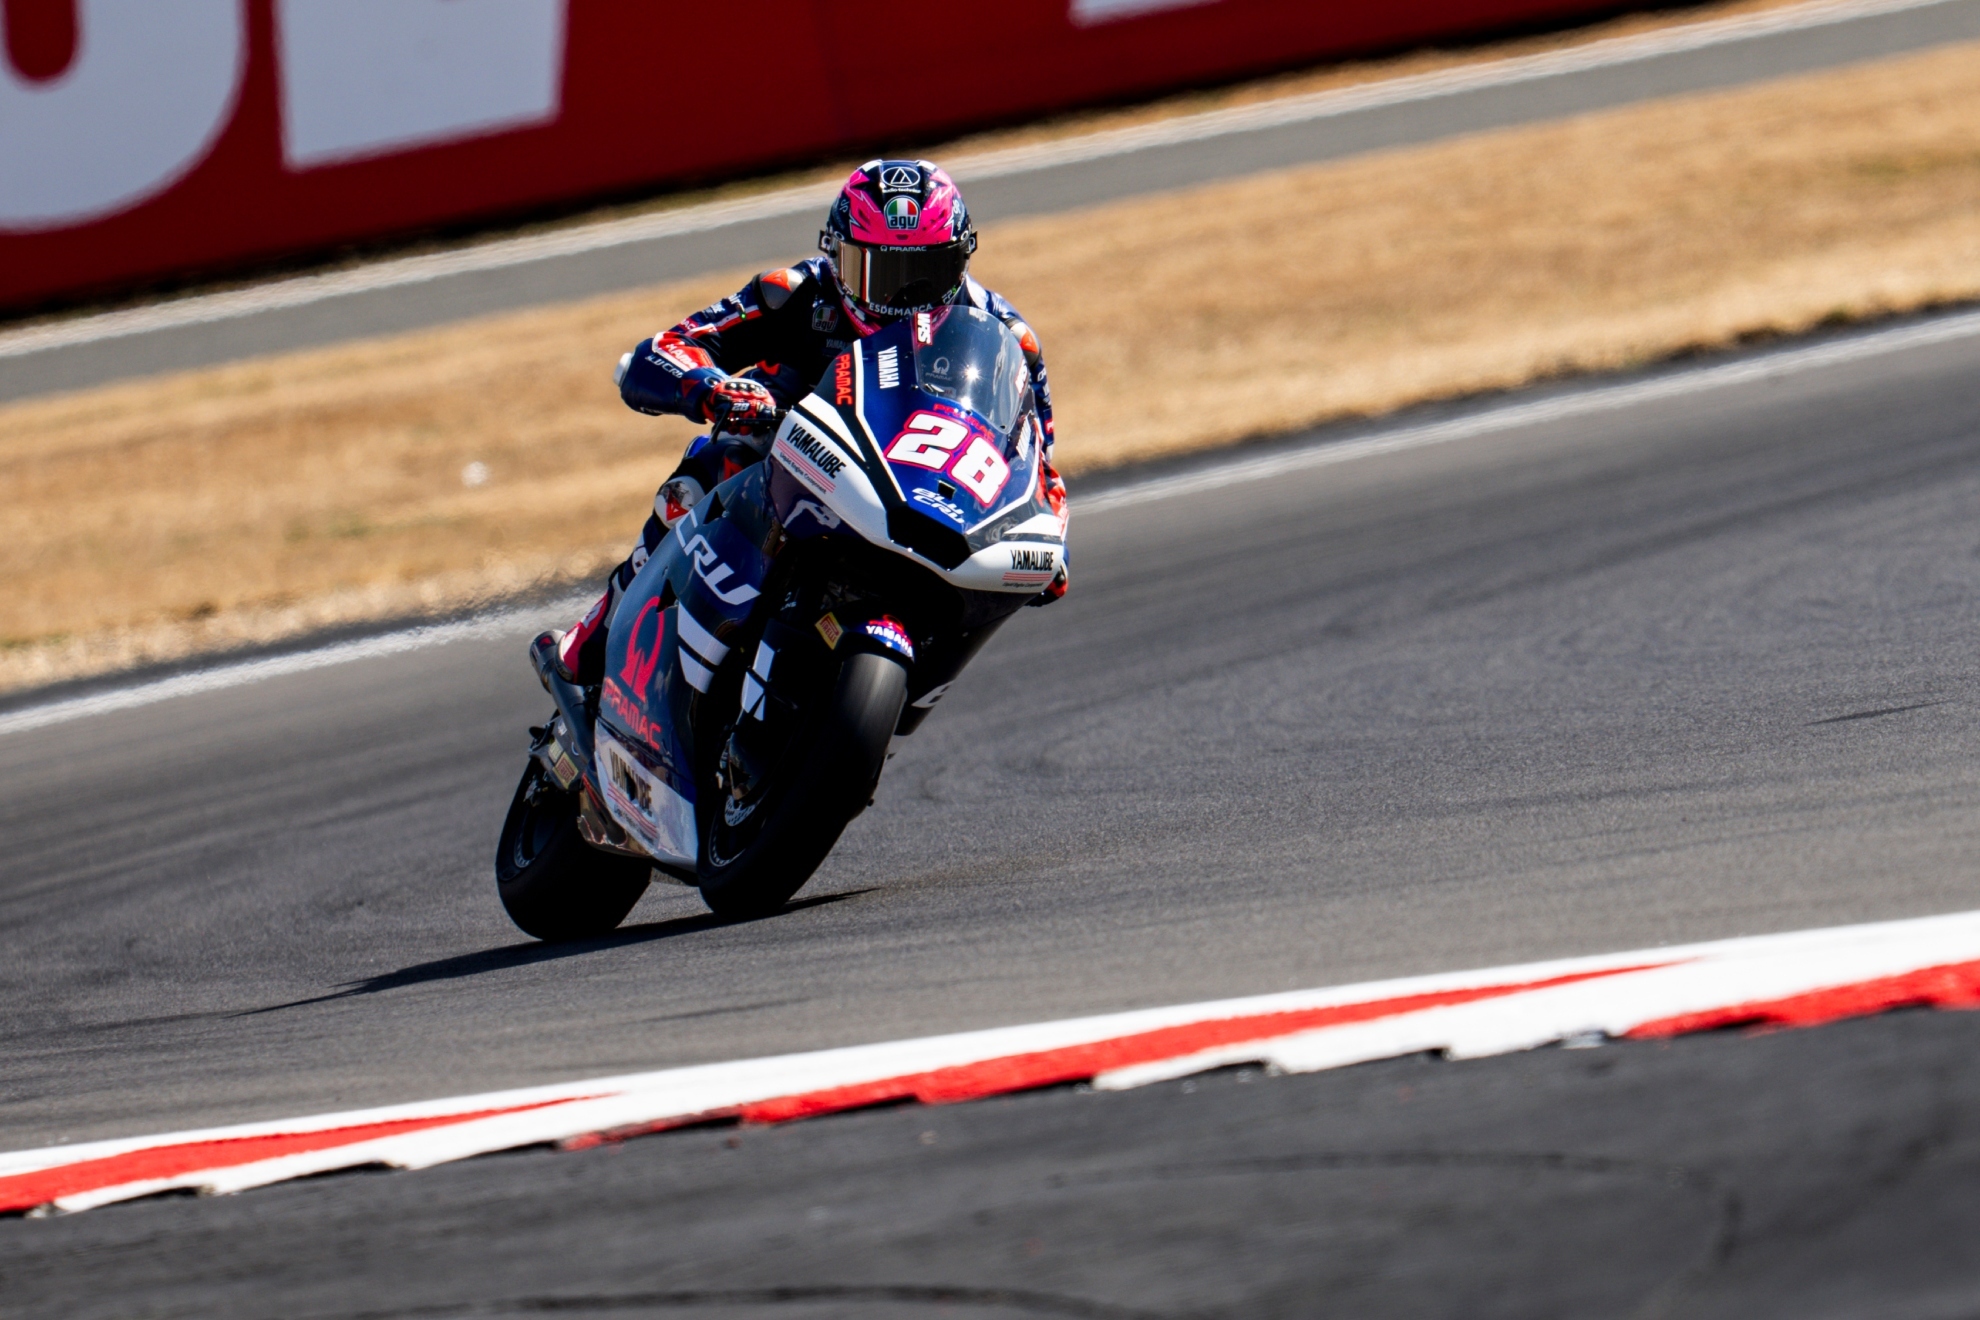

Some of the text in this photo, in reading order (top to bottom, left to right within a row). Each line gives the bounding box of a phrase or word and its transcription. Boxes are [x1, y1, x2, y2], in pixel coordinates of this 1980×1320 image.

[890, 216, 916, 229] agv
[815, 321, 833, 330] agv
[868, 302, 934, 317] ESDEMARCA
[834, 353, 853, 405] PRAMAC
[877, 345, 899, 389] YAMAHA
[785, 423, 847, 479] YAMALUBE
[884, 411, 1010, 507] 28
[913, 495, 965, 523] CRU
[675, 509, 762, 605] CRU
[1010, 549, 1053, 571] YAMALUBE
[865, 625, 913, 658] YAMAHA
[603, 676, 662, 750] PRAMAC
